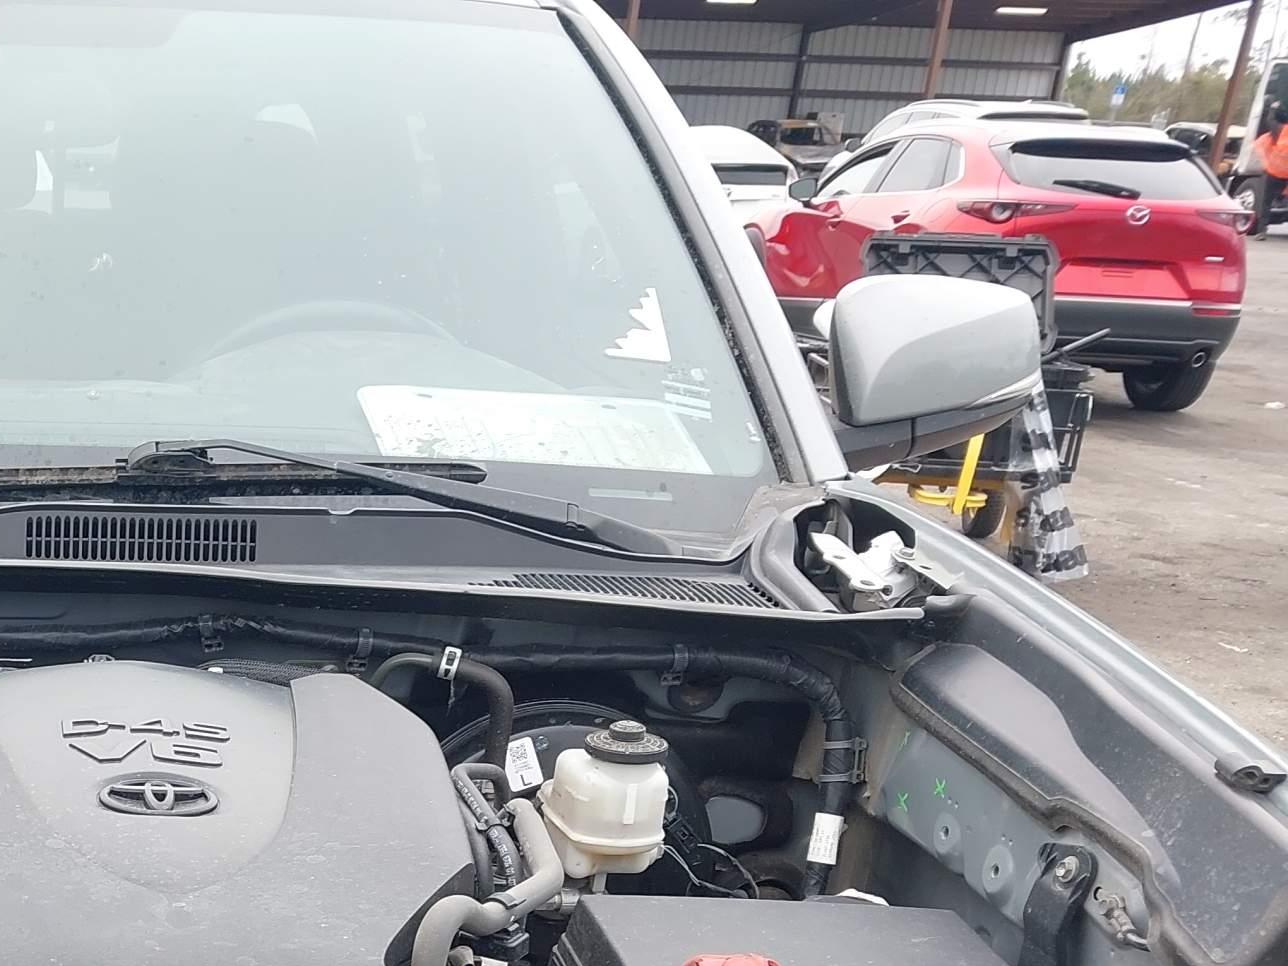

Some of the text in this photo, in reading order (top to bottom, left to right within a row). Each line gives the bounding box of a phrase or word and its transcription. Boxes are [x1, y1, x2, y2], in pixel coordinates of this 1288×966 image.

[61, 718, 231, 743] D-4S
[68, 739, 223, 767] V6
[520, 774, 533, 787] L
